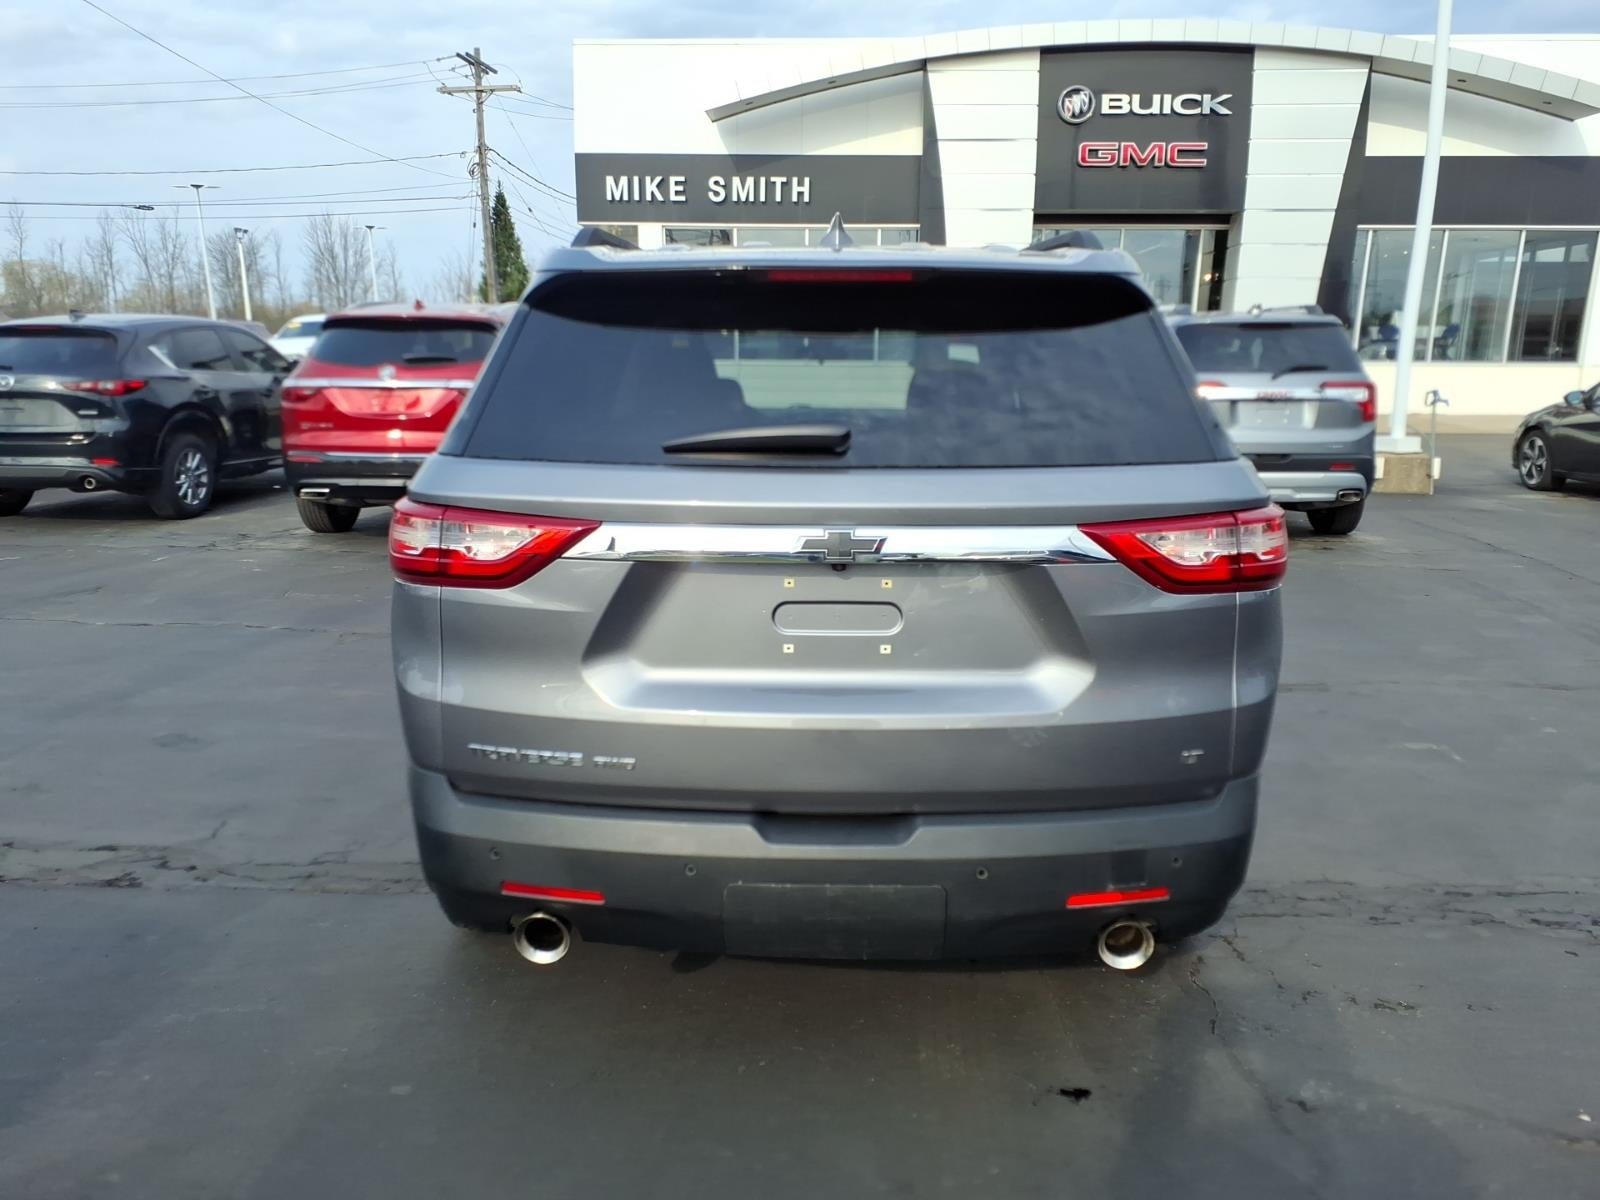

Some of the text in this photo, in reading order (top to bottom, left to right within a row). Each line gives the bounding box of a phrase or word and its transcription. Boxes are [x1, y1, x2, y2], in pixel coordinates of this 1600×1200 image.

[1100, 93, 1233, 115] BUICK
[1078, 141, 1208, 167] GMC
[605, 175, 811, 203] MIKE SMITH
